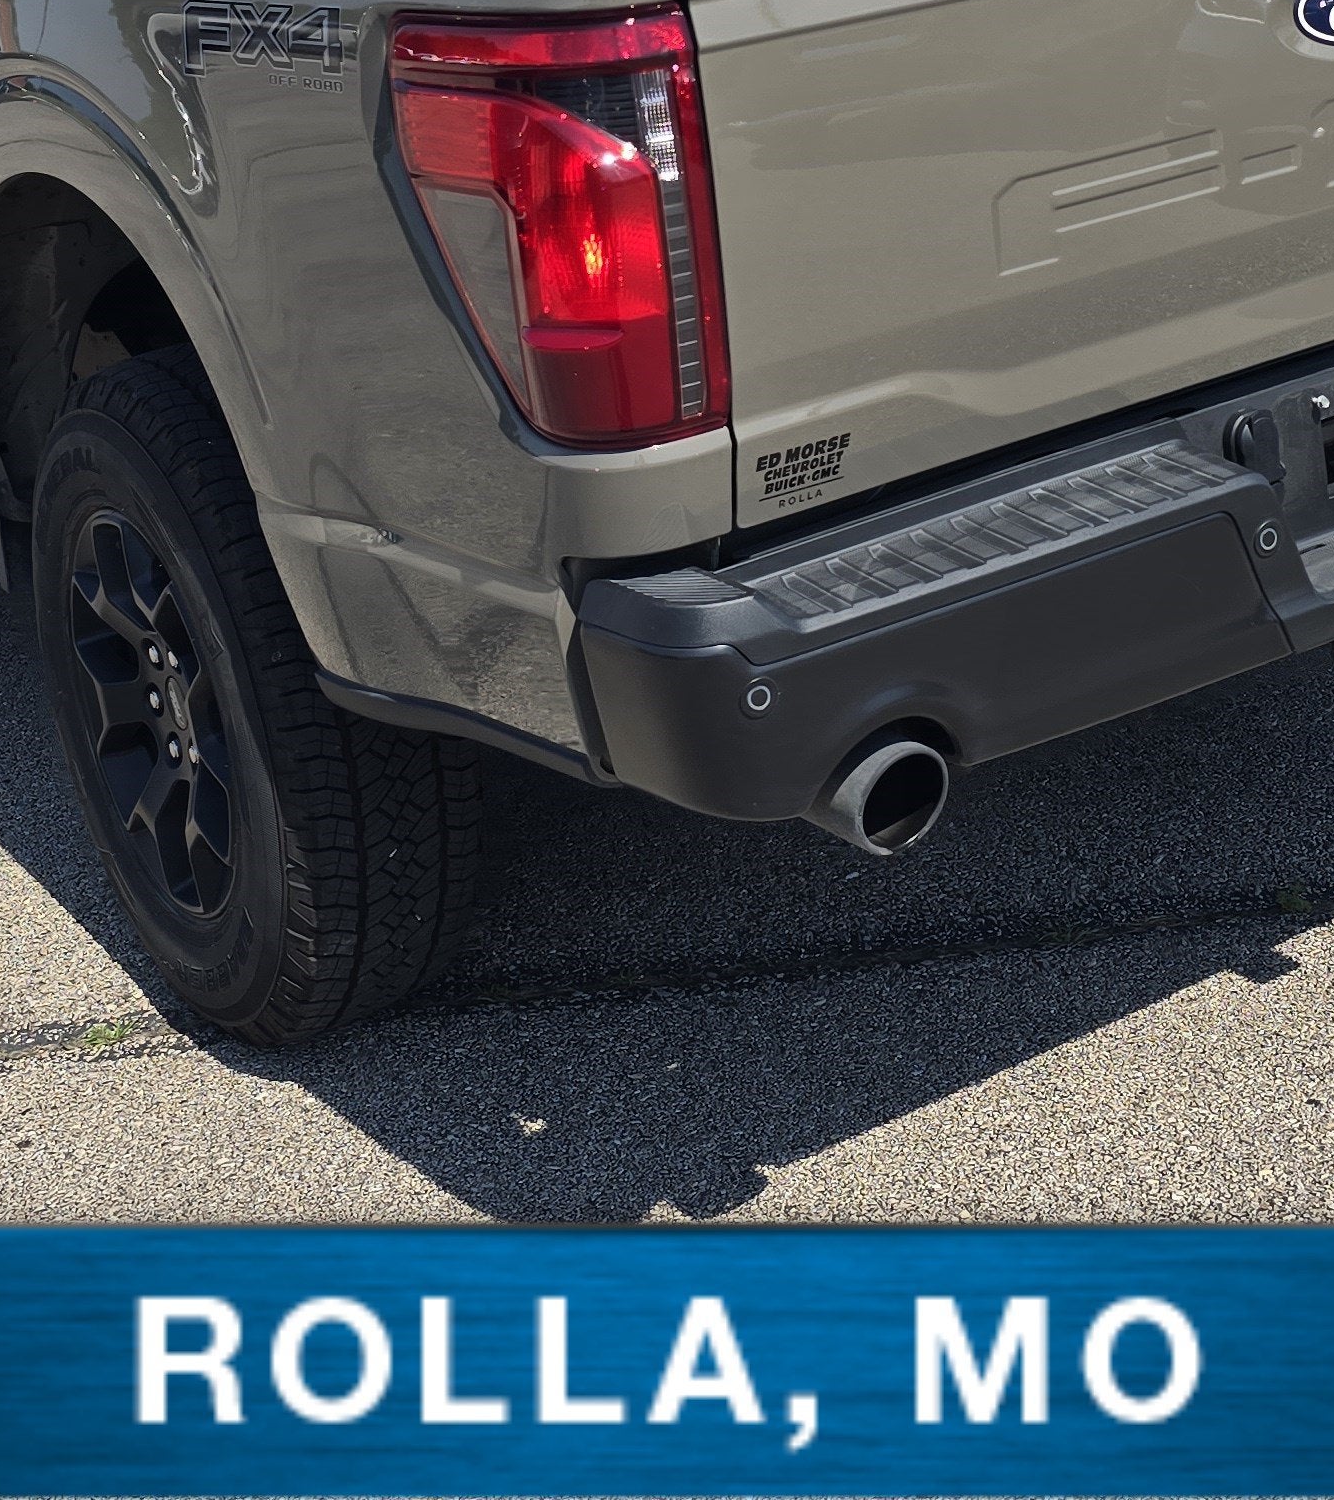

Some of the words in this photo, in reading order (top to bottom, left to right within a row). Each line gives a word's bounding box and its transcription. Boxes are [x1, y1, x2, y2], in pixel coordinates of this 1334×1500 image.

[755, 451, 782, 472] ED
[784, 432, 851, 465] MORSE
[763, 450, 844, 482] CHEVROLET
[778, 488, 823, 509] ROLLA
